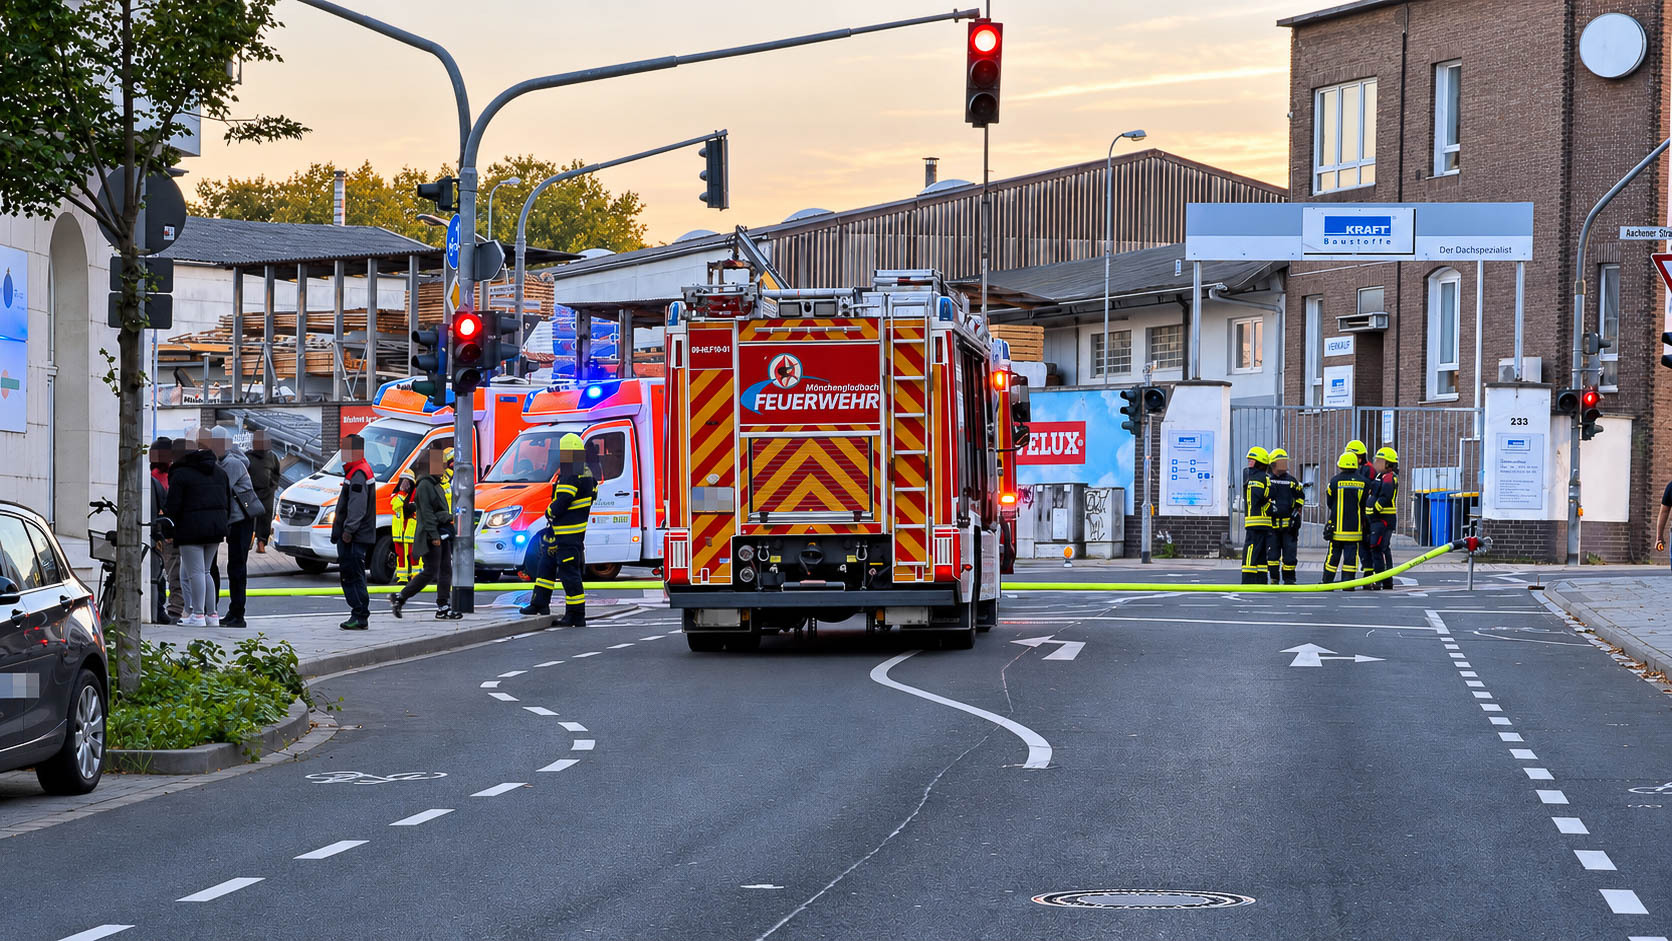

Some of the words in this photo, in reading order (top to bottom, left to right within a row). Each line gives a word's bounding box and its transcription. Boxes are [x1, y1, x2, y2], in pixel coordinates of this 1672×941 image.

[1346, 225, 1389, 234] KRAFT
[1439, 246, 1454, 254] Der
[1455, 245, 1512, 255] Dachspezialist
[805, 384, 880, 392] Mönchengladbach
[754, 393, 880, 411] FEUERWEHR
[1016, 431, 1080, 456] ELUX
